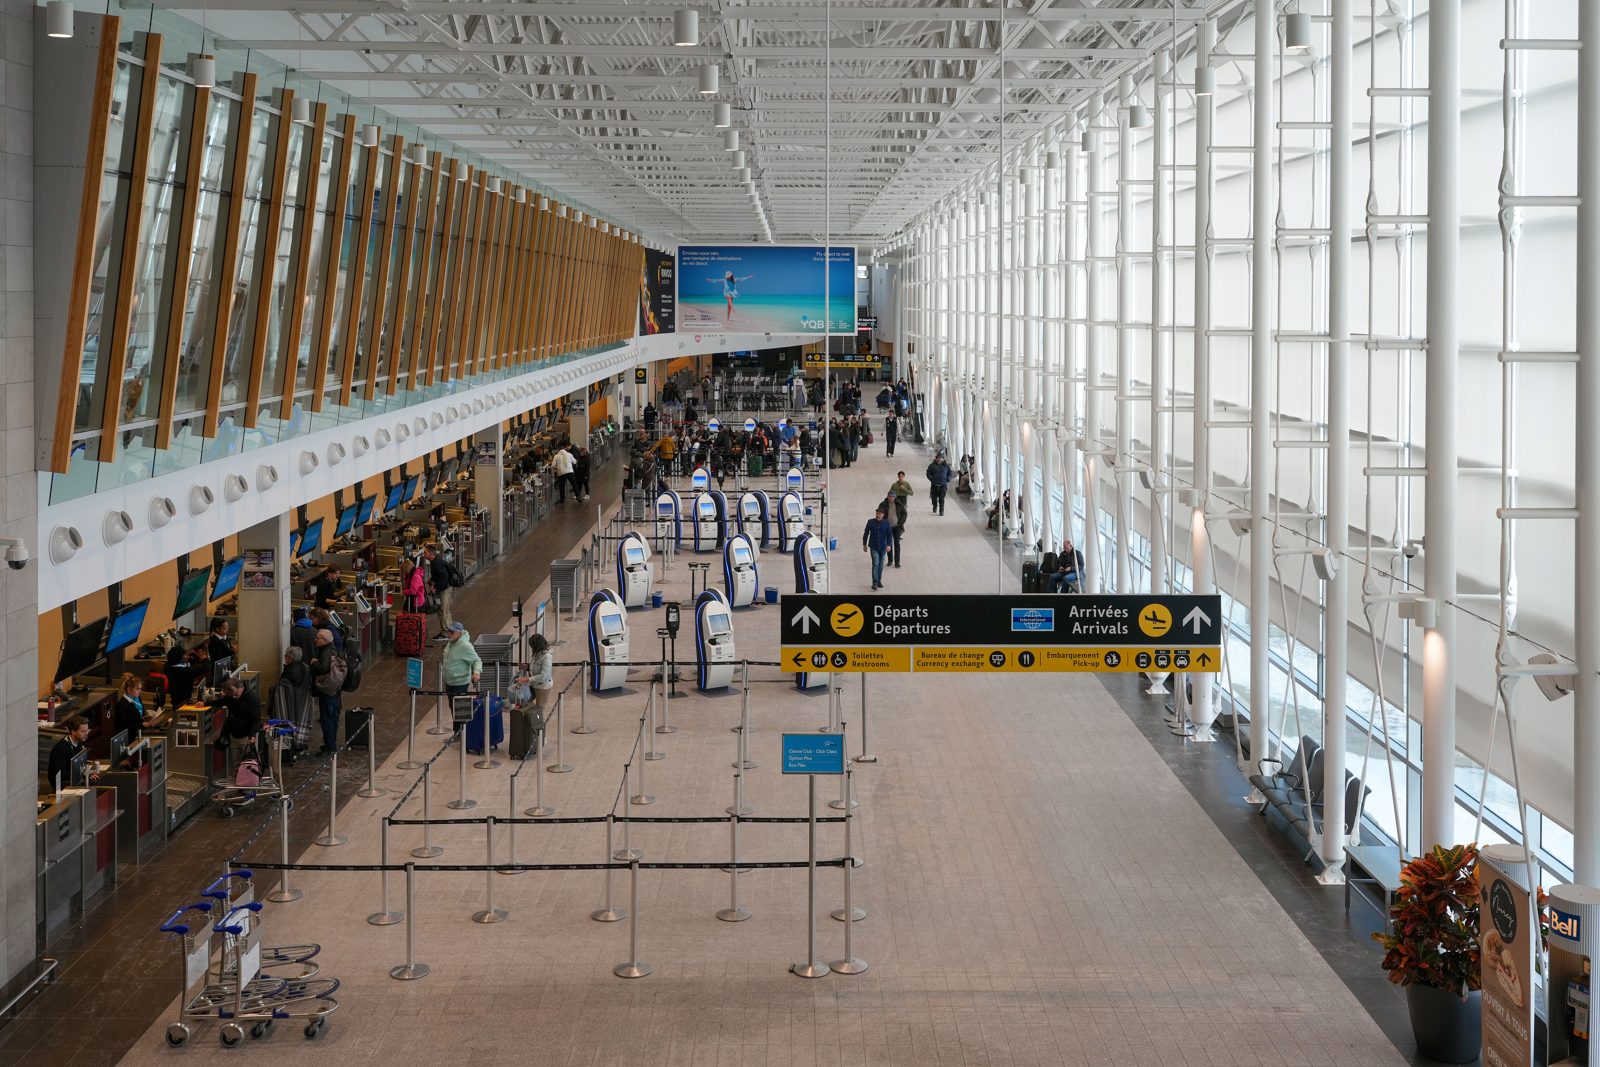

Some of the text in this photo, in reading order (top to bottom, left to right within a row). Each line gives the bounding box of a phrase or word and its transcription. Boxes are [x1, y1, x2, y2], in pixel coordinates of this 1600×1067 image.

[800, 320, 824, 329] YQB
[874, 605, 928, 621] Départs
[1069, 605, 1129, 618] Arrivées
[874, 622, 950, 638] Departures
[1072, 622, 1129, 635] Arrivals
[959, 652, 984, 660] change
[1046, 652, 1099, 661] Embarquement
[916, 660, 984, 669] Currency exchange
[1551, 910, 1577, 938] Bell
[1483, 989, 1504, 1018] OUVERT
[1512, 1016, 1528, 1040] TOUS
